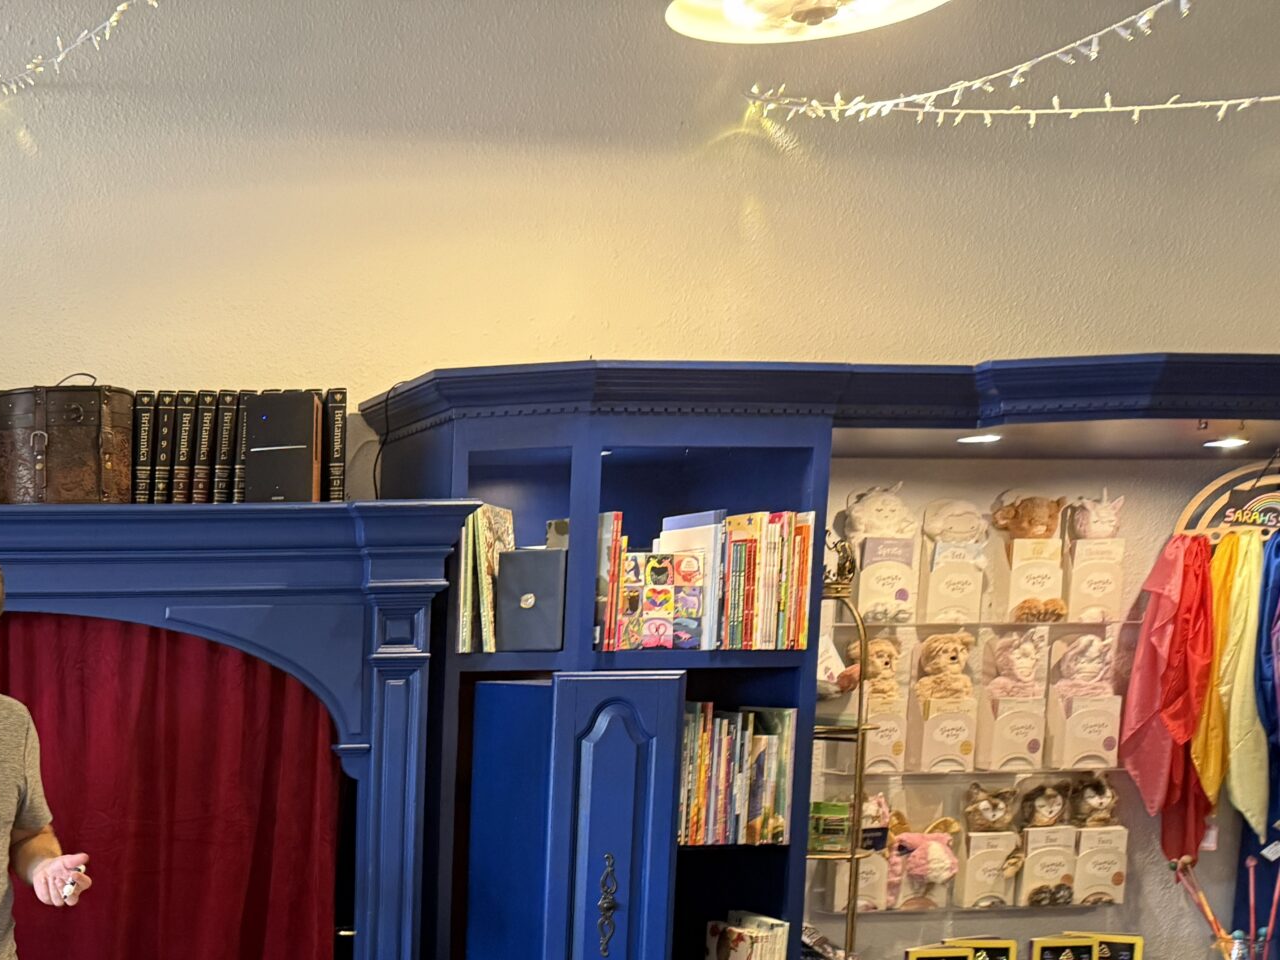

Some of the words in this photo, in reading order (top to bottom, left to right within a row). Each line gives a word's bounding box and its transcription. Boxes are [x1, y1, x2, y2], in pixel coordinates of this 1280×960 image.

[140, 413, 150, 461] Britannica
[180, 413, 191, 461] Britannica
[200, 412, 212, 460] Britannica
[220, 412, 232, 460] Britannica
[333, 410, 344, 457] Britannica
